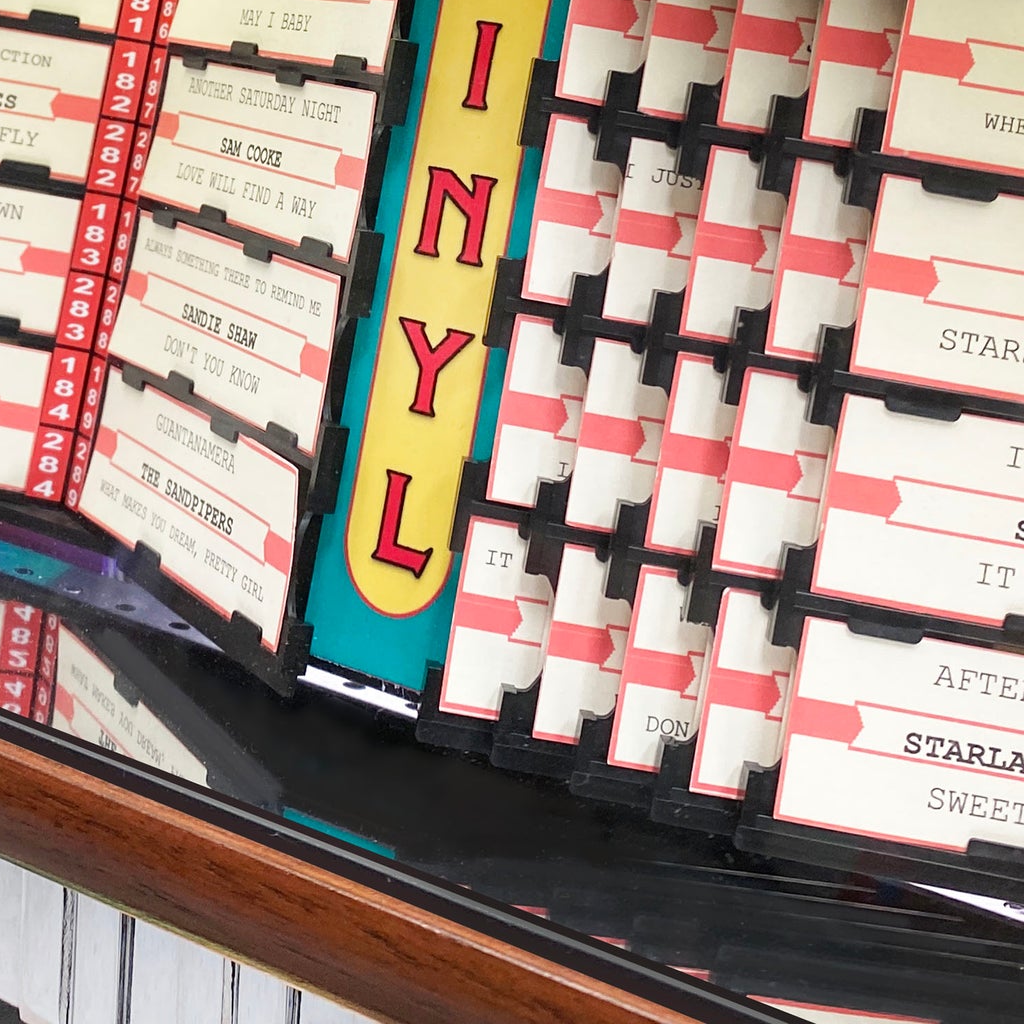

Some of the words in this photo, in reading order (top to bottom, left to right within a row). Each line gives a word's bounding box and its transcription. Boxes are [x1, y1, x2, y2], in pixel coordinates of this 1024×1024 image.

[240, 9, 262, 27] MAY
[268, 11, 275, 28] I
[281, 13, 312, 32] BABY
[188, 77, 233, 101] ANOTHER
[239, 88, 296, 114] SATURDAY
[302, 99, 342, 124] NIGHT
[220, 137, 242, 157] SAM
[247, 144, 282, 168] COOKE
[176, 162, 205, 185] LOVE
[209, 172, 235, 196] WILL
[242, 182, 271, 205] FIND
[276, 191, 284, 211] A
[290, 195, 317, 219] WAY
[145, 238, 173, 260] ALWAYS
[176, 249, 220, 277] SOMETHING
[224, 267, 250, 289] THERE
[255, 278, 266, 295] TO
[271, 287, 305, 309] REMIND
[309, 300, 322, 317] ME
[181, 303, 222, 335] SANDIE
[227, 322, 258, 350] SHAW
[939, 328, 1024, 363] STAR
[164, 334, 198, 364] DON'T
[204, 355, 224, 378] YOU
[229, 365, 260, 394] KNOW
[156, 413, 236, 475] GUANTANAMERA
[141, 463, 160, 489] THE
[165, 479, 234, 536] SANDPIPERS
[99, 478, 121, 504] WHAT
[123, 494, 147, 521] MAKES
[151, 512, 165, 533] YOU
[169, 524, 197, 559] DREAM,
[204, 548, 237, 583] PRETTY
[240, 571, 264, 603] GIRL
[485, 549, 513, 569] IT
[933, 665, 1024, 702] AFTE
